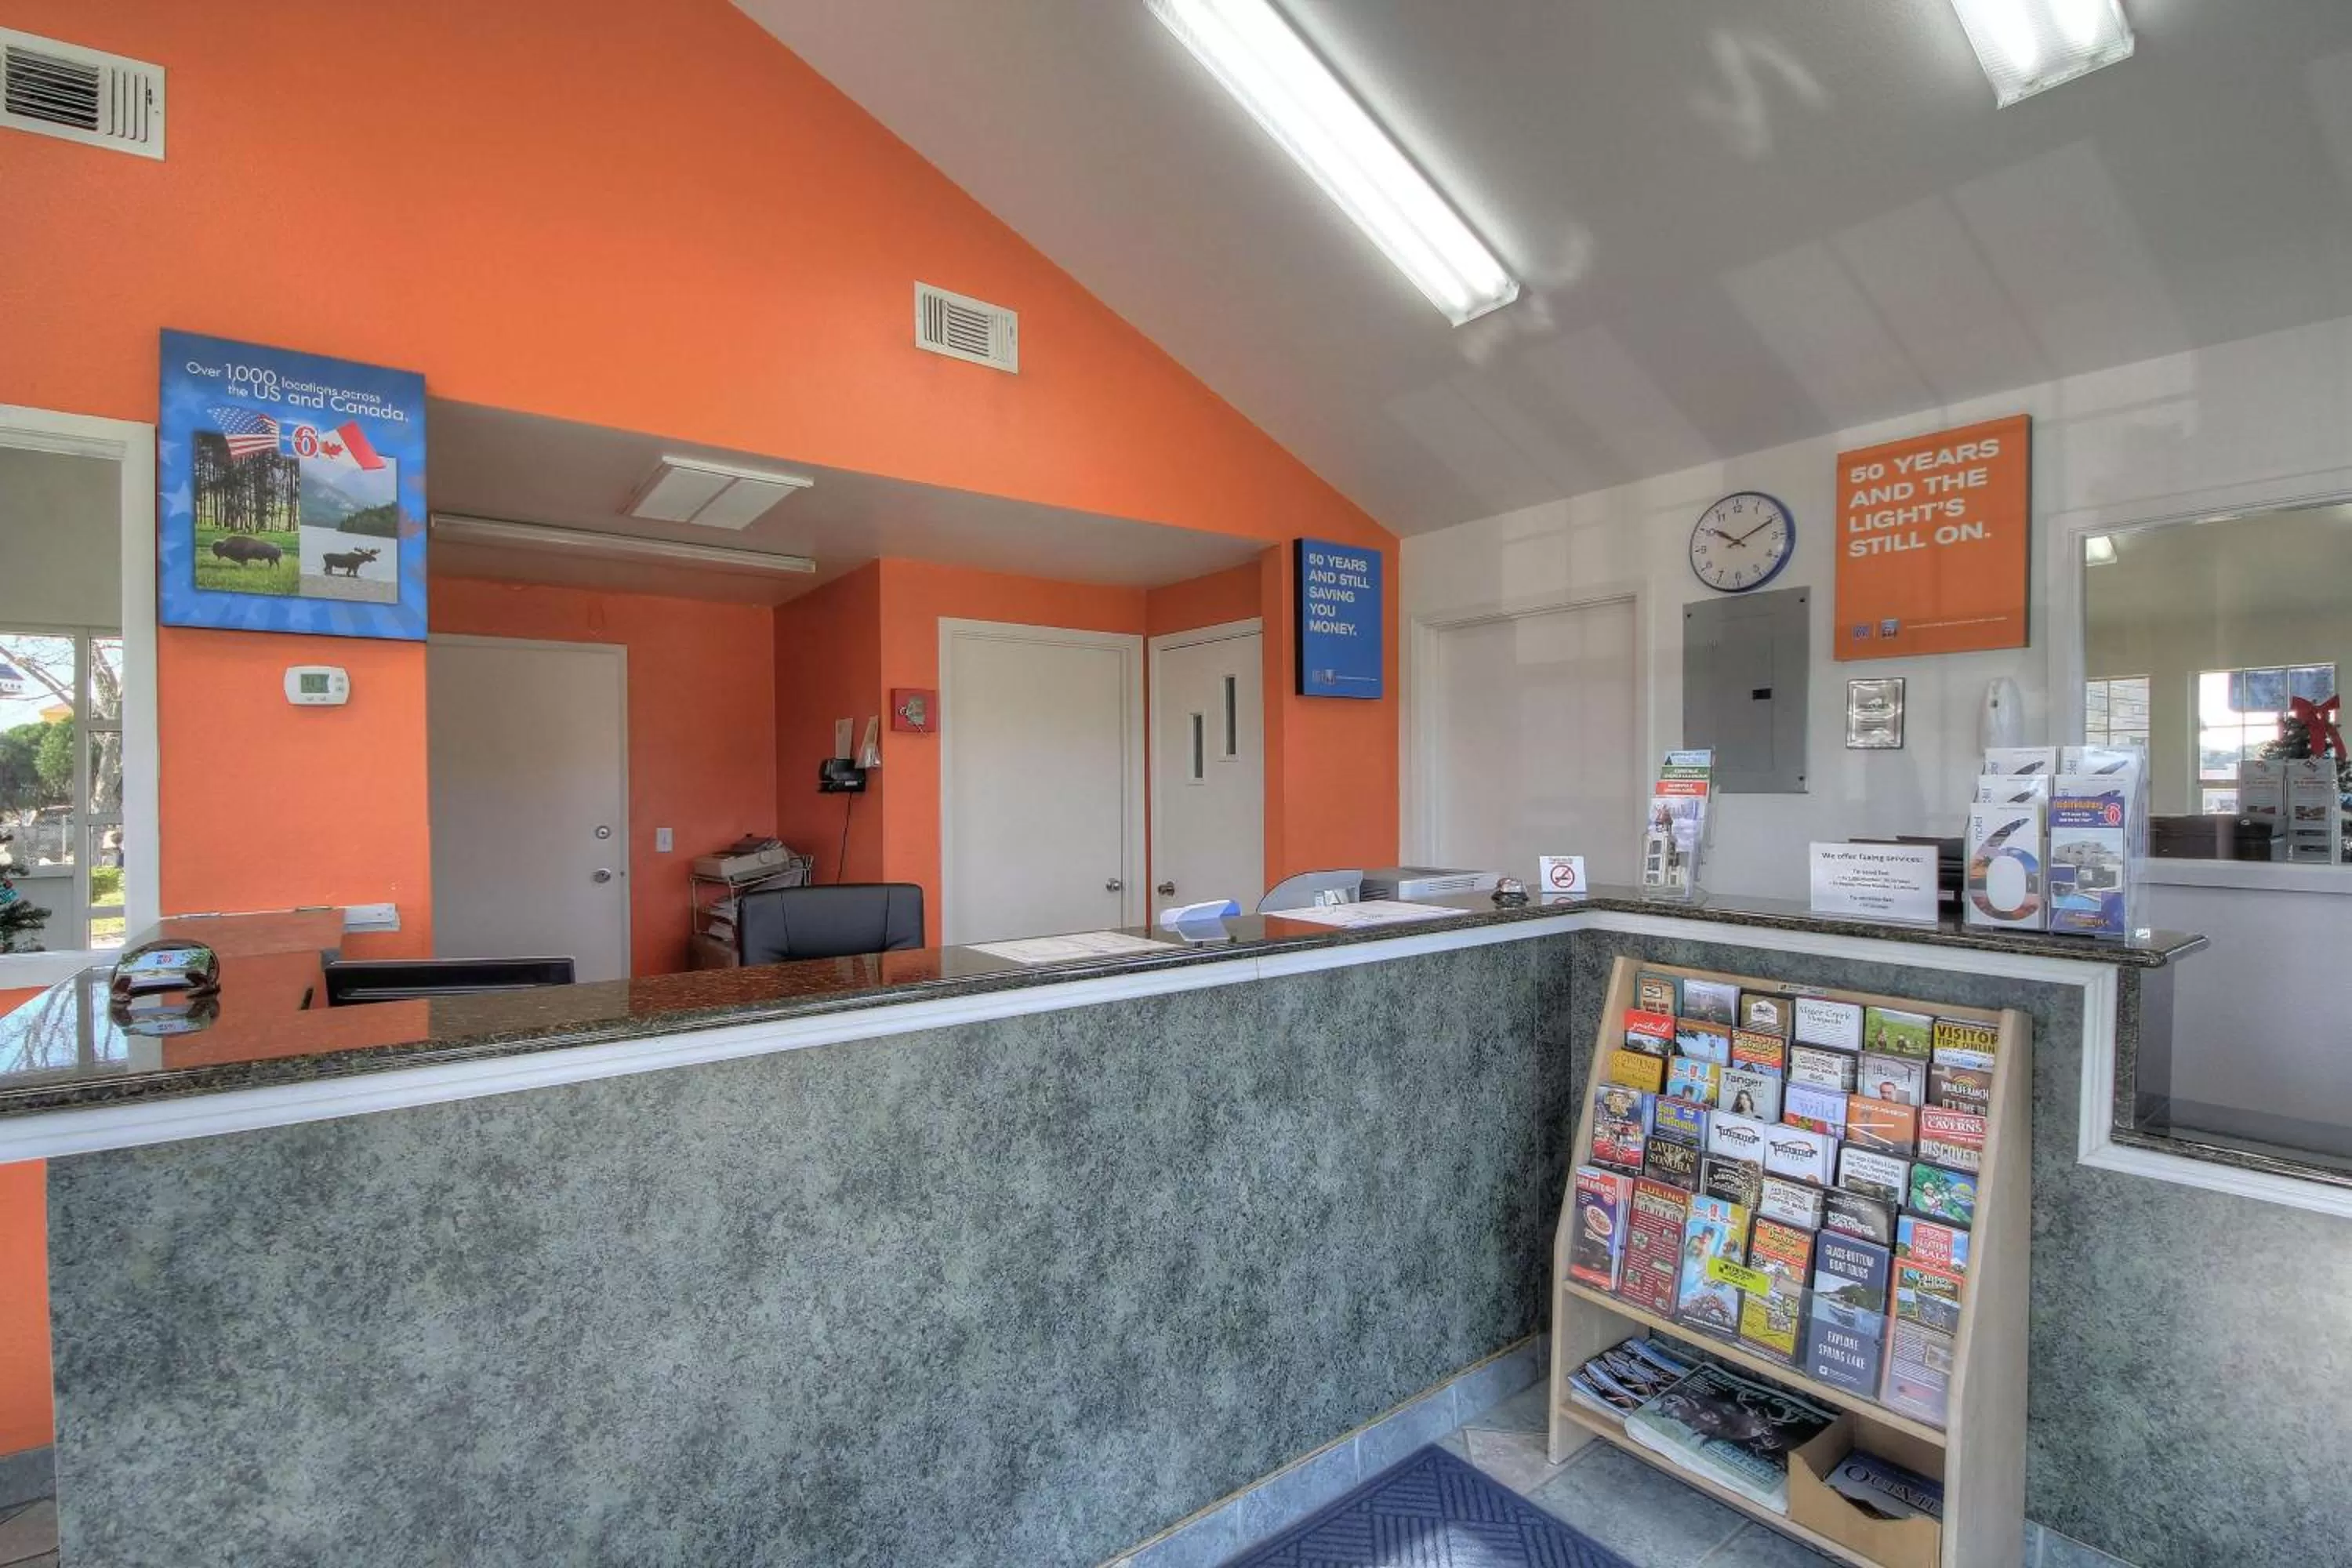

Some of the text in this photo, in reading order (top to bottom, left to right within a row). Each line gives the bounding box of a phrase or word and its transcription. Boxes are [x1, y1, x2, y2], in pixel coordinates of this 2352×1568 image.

[186, 361, 381, 403] Over 1,000 locations across
[227, 383, 408, 423] the US and Canada.
[292, 424, 318, 457] 6
[1850, 439, 1999, 483] 50 YEARS
[1849, 467, 1987, 508] AND THE
[1849, 498, 1965, 532] LIGHT'S
[1849, 521, 1991, 557] STILL ON.
[1327, 555, 1367, 572] YEARS
[1309, 568, 1370, 589] AND STILL
[1309, 586, 1355, 603] SAVING
[1309, 603, 1336, 616] YOU
[1309, 619, 1357, 636] MONEY.
[1859, 853, 1884, 862] faxing
[1937, 1037, 1994, 1054] TIPS ONLIN
[1725, 1072, 1762, 1087] Tanger
[1657, 1114, 1697, 1131] Antonio
[1928, 1120, 1982, 1133] CAVERNS
[1650, 1141, 1696, 1162] CAVERNS
[1639, 1181, 1683, 1203] LULING
